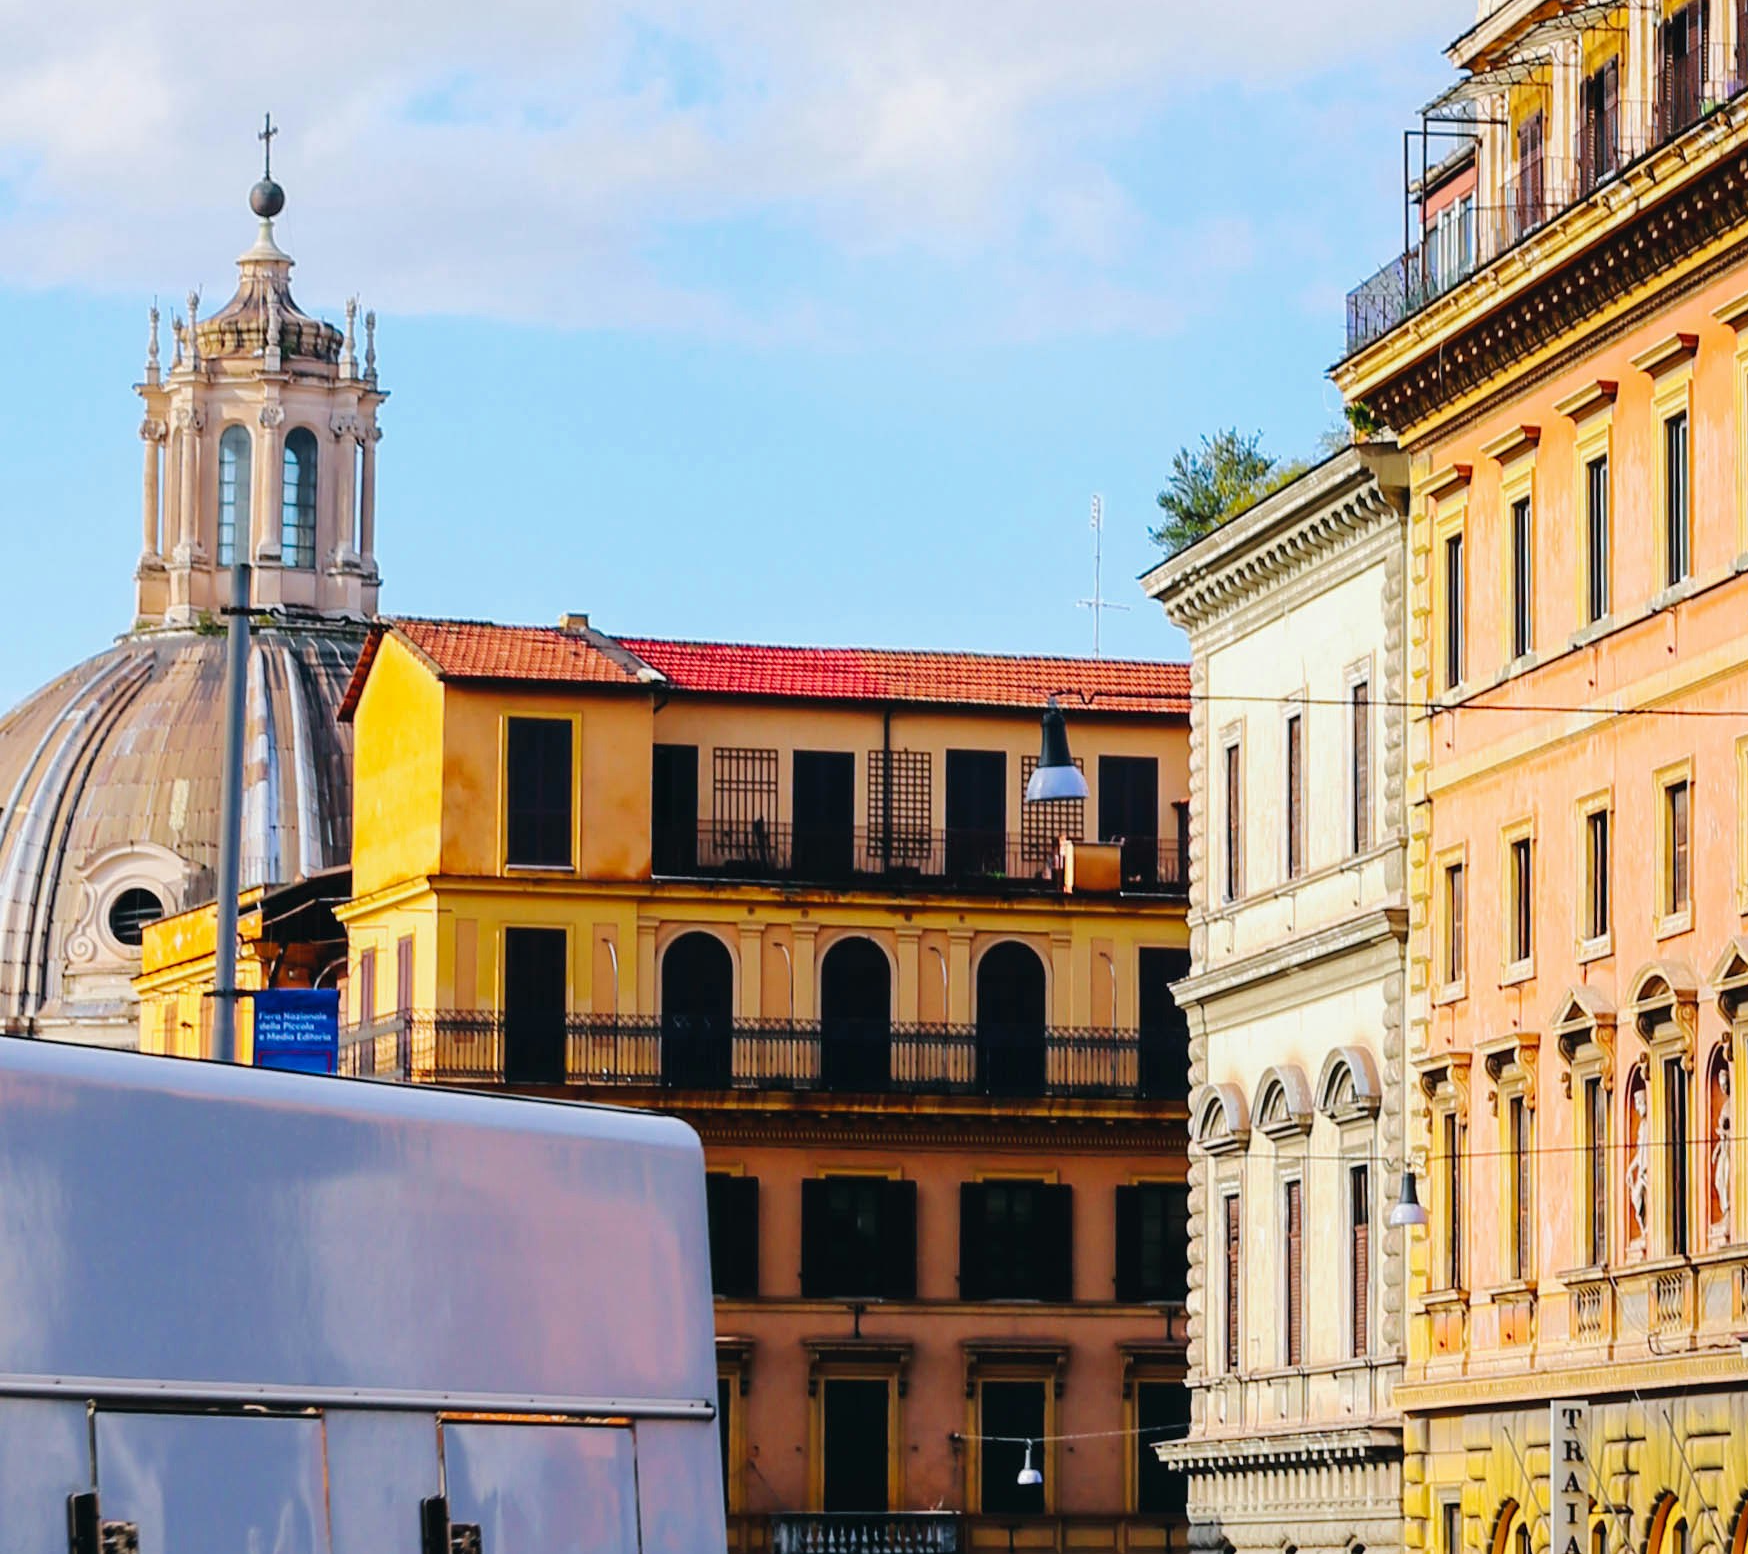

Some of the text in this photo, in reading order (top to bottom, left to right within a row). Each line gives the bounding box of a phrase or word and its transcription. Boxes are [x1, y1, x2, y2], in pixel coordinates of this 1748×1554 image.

[258, 1012, 328, 1021] Fiera Nazionale
[259, 1022, 315, 1031] della Piccola
[266, 1032, 295, 1041] Media
[296, 1032, 332, 1041] Editoria
